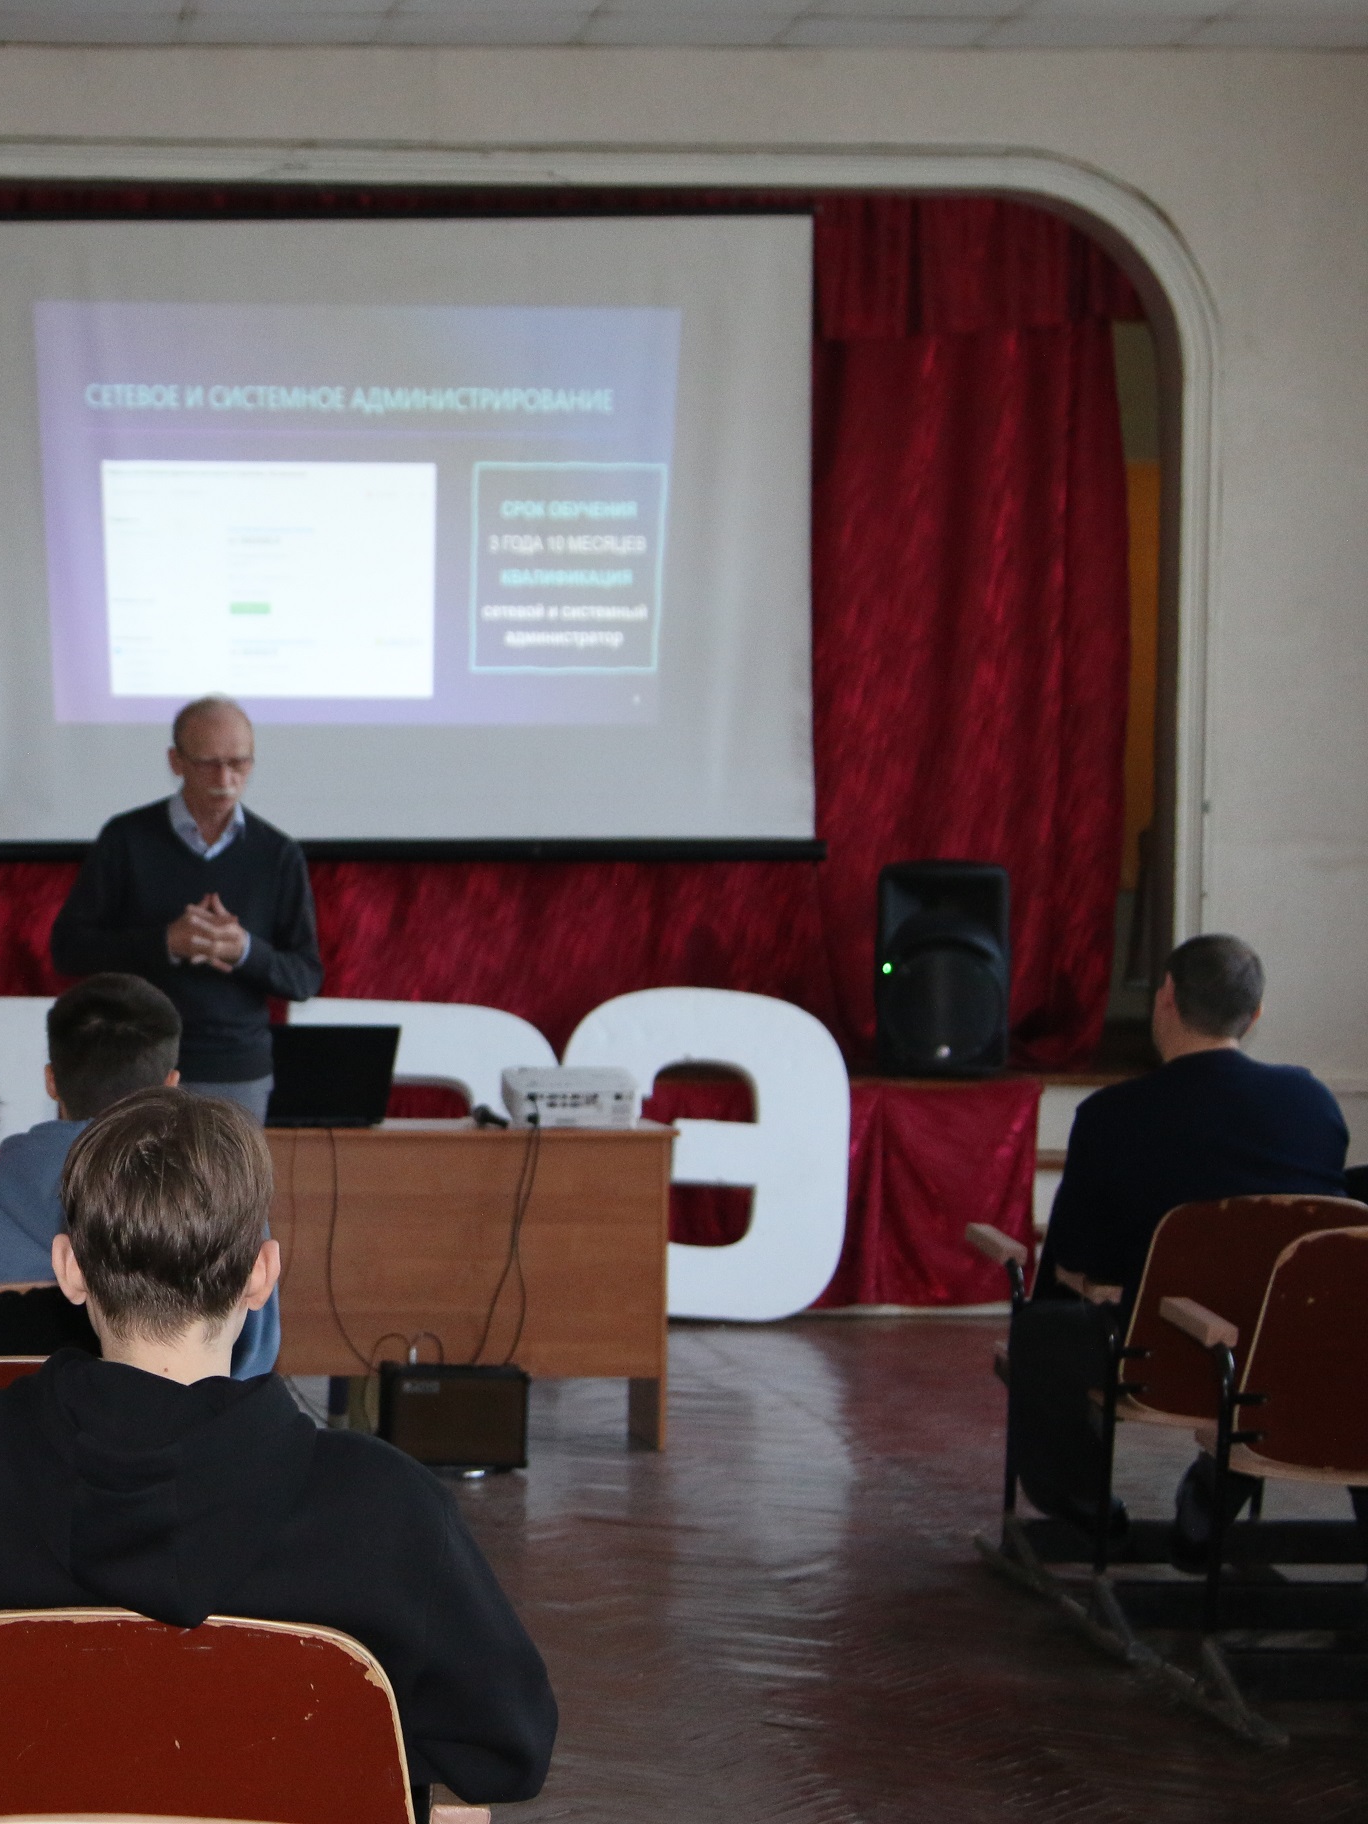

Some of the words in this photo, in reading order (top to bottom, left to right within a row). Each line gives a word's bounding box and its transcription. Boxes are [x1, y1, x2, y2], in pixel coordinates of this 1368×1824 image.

[84, 384, 180, 410] СЕТЕВОЕ
[185, 385, 206, 410] И
[208, 385, 346, 411] СИСТЕМНОЕ
[351, 387, 613, 413] АДМИНИСТРИРОВАНИЕ
[500, 534, 544, 554] ГОДА
[567, 534, 648, 554] МЕСЯЦЕВ
